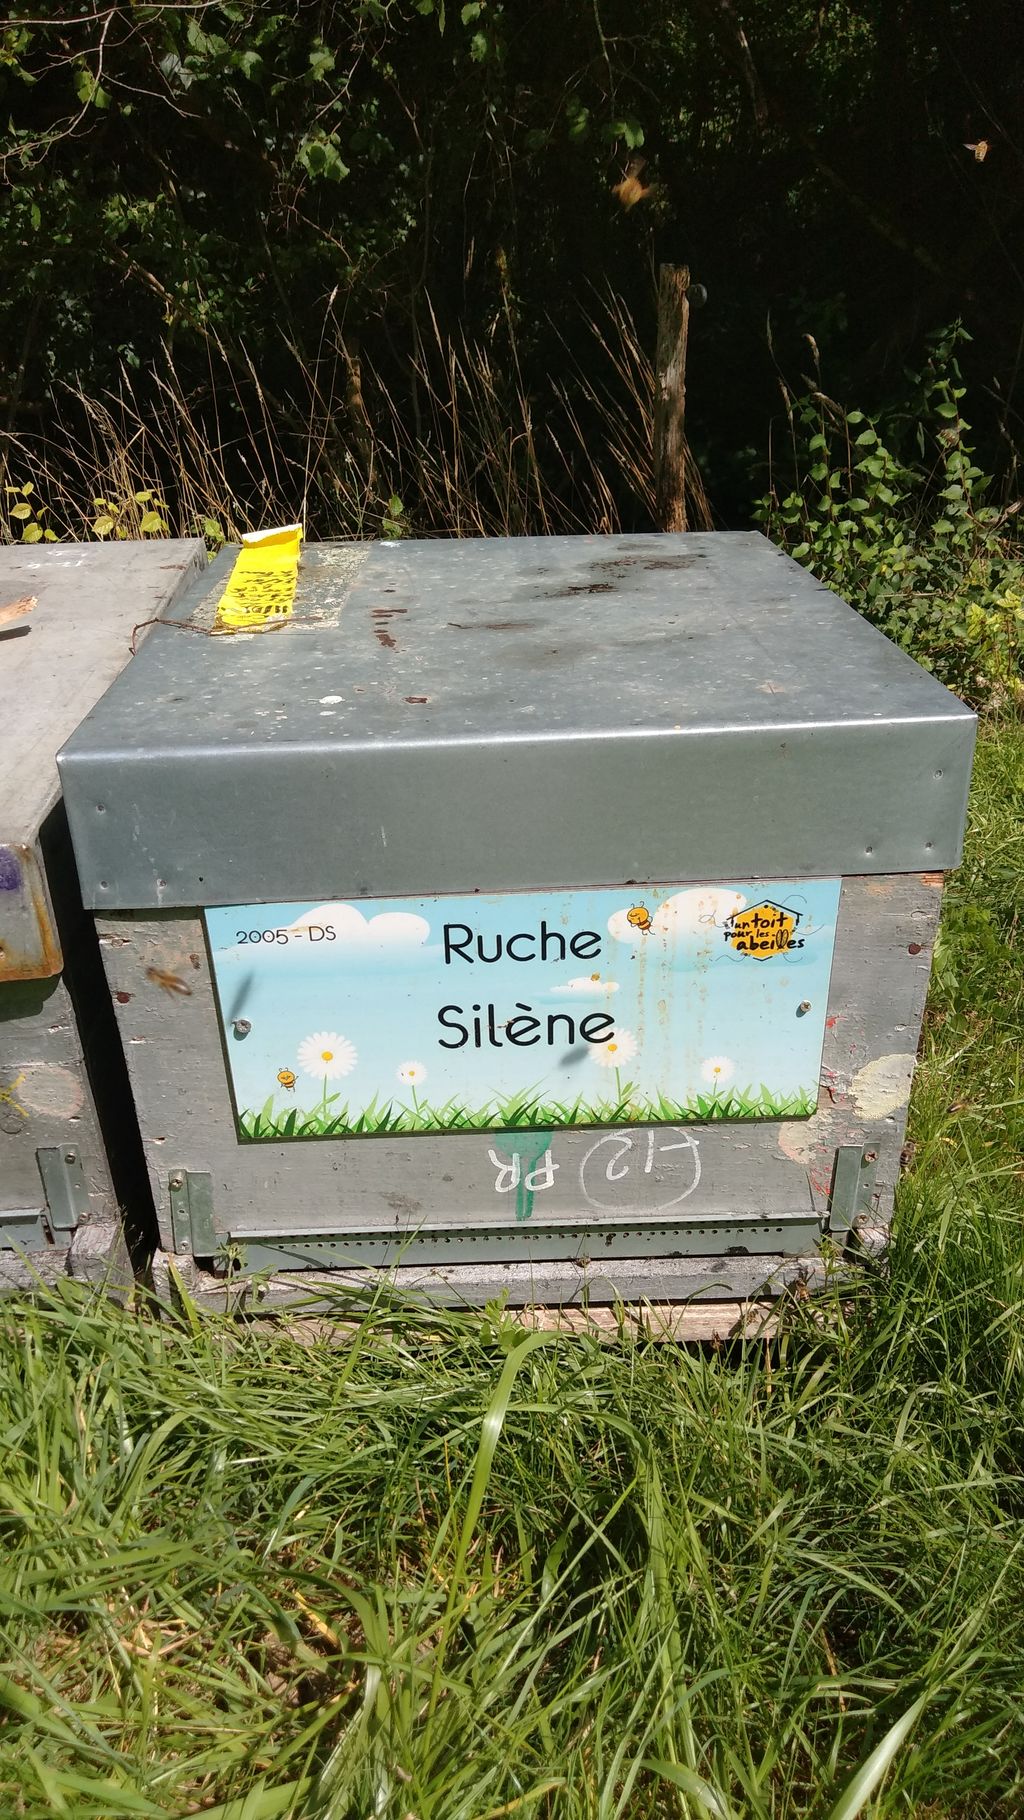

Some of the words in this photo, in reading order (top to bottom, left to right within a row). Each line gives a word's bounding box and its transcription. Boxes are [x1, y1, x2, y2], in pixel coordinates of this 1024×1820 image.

[734, 921, 750, 930] un
[750, 911, 789, 929] toit
[235, 928, 290, 945] 2005
[308, 925, 337, 942] DS
[443, 920, 602, 965] Ruche
[723, 929, 753, 942] pour
[756, 928, 770, 938] les
[736, 928, 806, 951] abeilles
[437, 1002, 616, 1049] Silène
